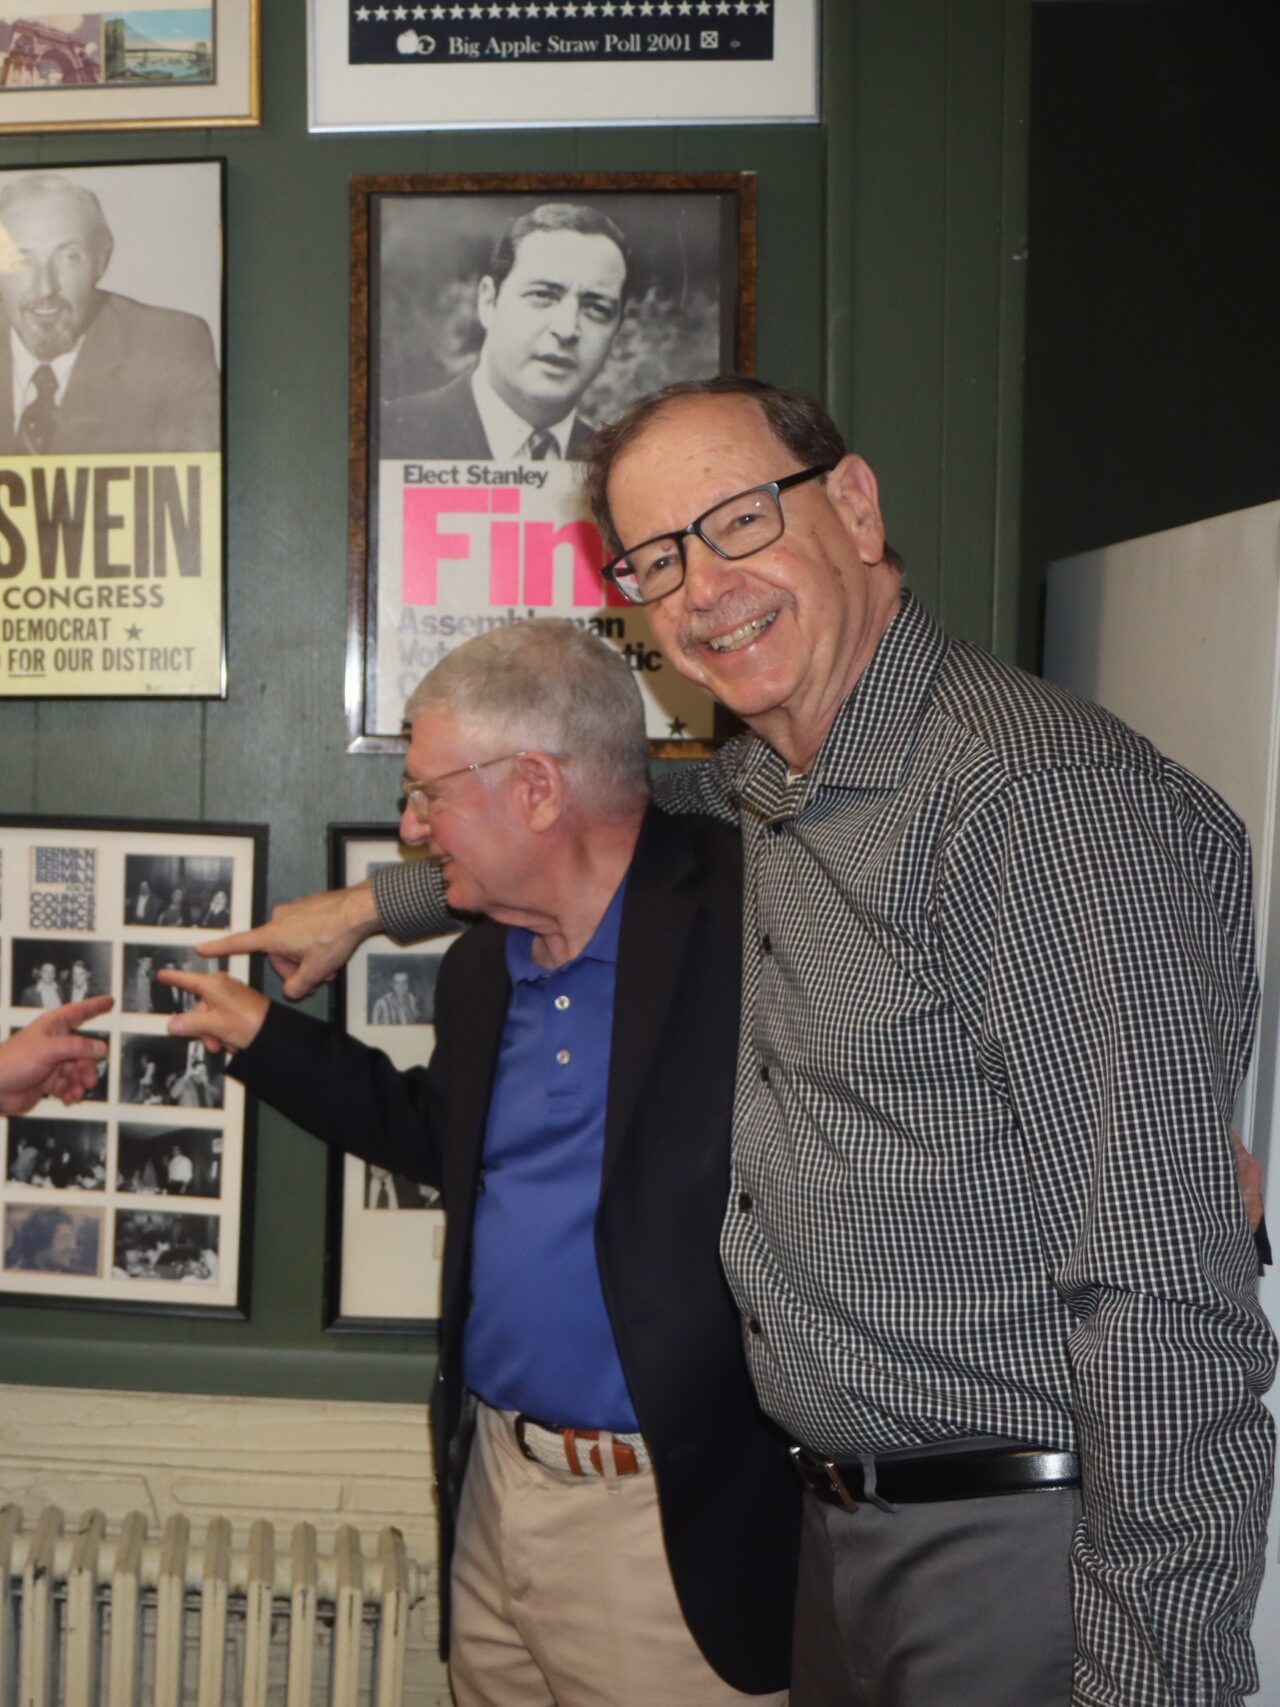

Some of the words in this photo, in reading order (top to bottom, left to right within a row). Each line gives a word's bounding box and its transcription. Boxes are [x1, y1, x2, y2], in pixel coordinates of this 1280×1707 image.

[448, 36, 480, 58] Big
[485, 35, 542, 58] Apple
[548, 35, 599, 53] Straw
[604, 33, 641, 52] Poll
[647, 33, 691, 52] 2001
[403, 464, 459, 484] Elect
[466, 465, 549, 488] Stanley
[401, 487, 634, 607] Fin
[2, 585, 165, 609] CONGRESS
[2, 617, 111, 642] DEMOCRAT
[8, 649, 46, 673] FOR
[53, 648, 93, 672] OUR
[102, 647, 195, 672] DISTRICT
[36, 847, 95, 860] BERMAN
[36, 859, 95, 872] BERMAN
[36, 871, 95, 884] BERMAN
